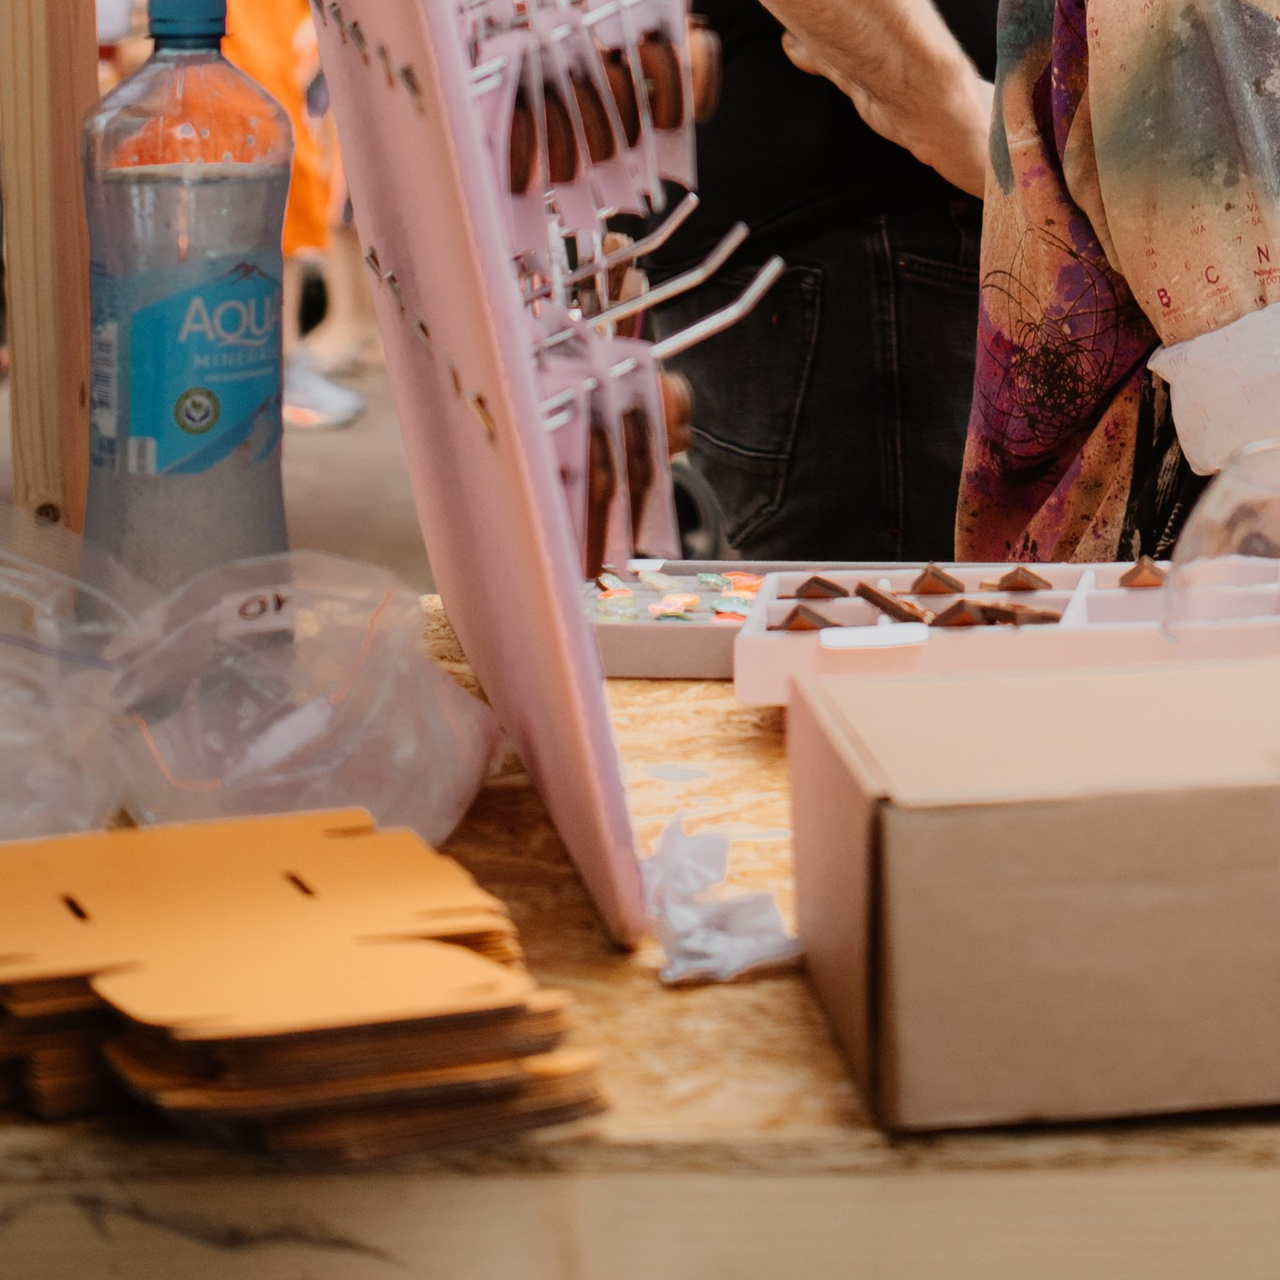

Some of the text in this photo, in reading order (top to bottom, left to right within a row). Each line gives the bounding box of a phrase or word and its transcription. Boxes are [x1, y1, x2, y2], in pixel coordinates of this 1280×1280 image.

[1256, 244, 1271, 264] N
[1205, 265, 1220, 284] C
[1157, 288, 1171, 308] B
